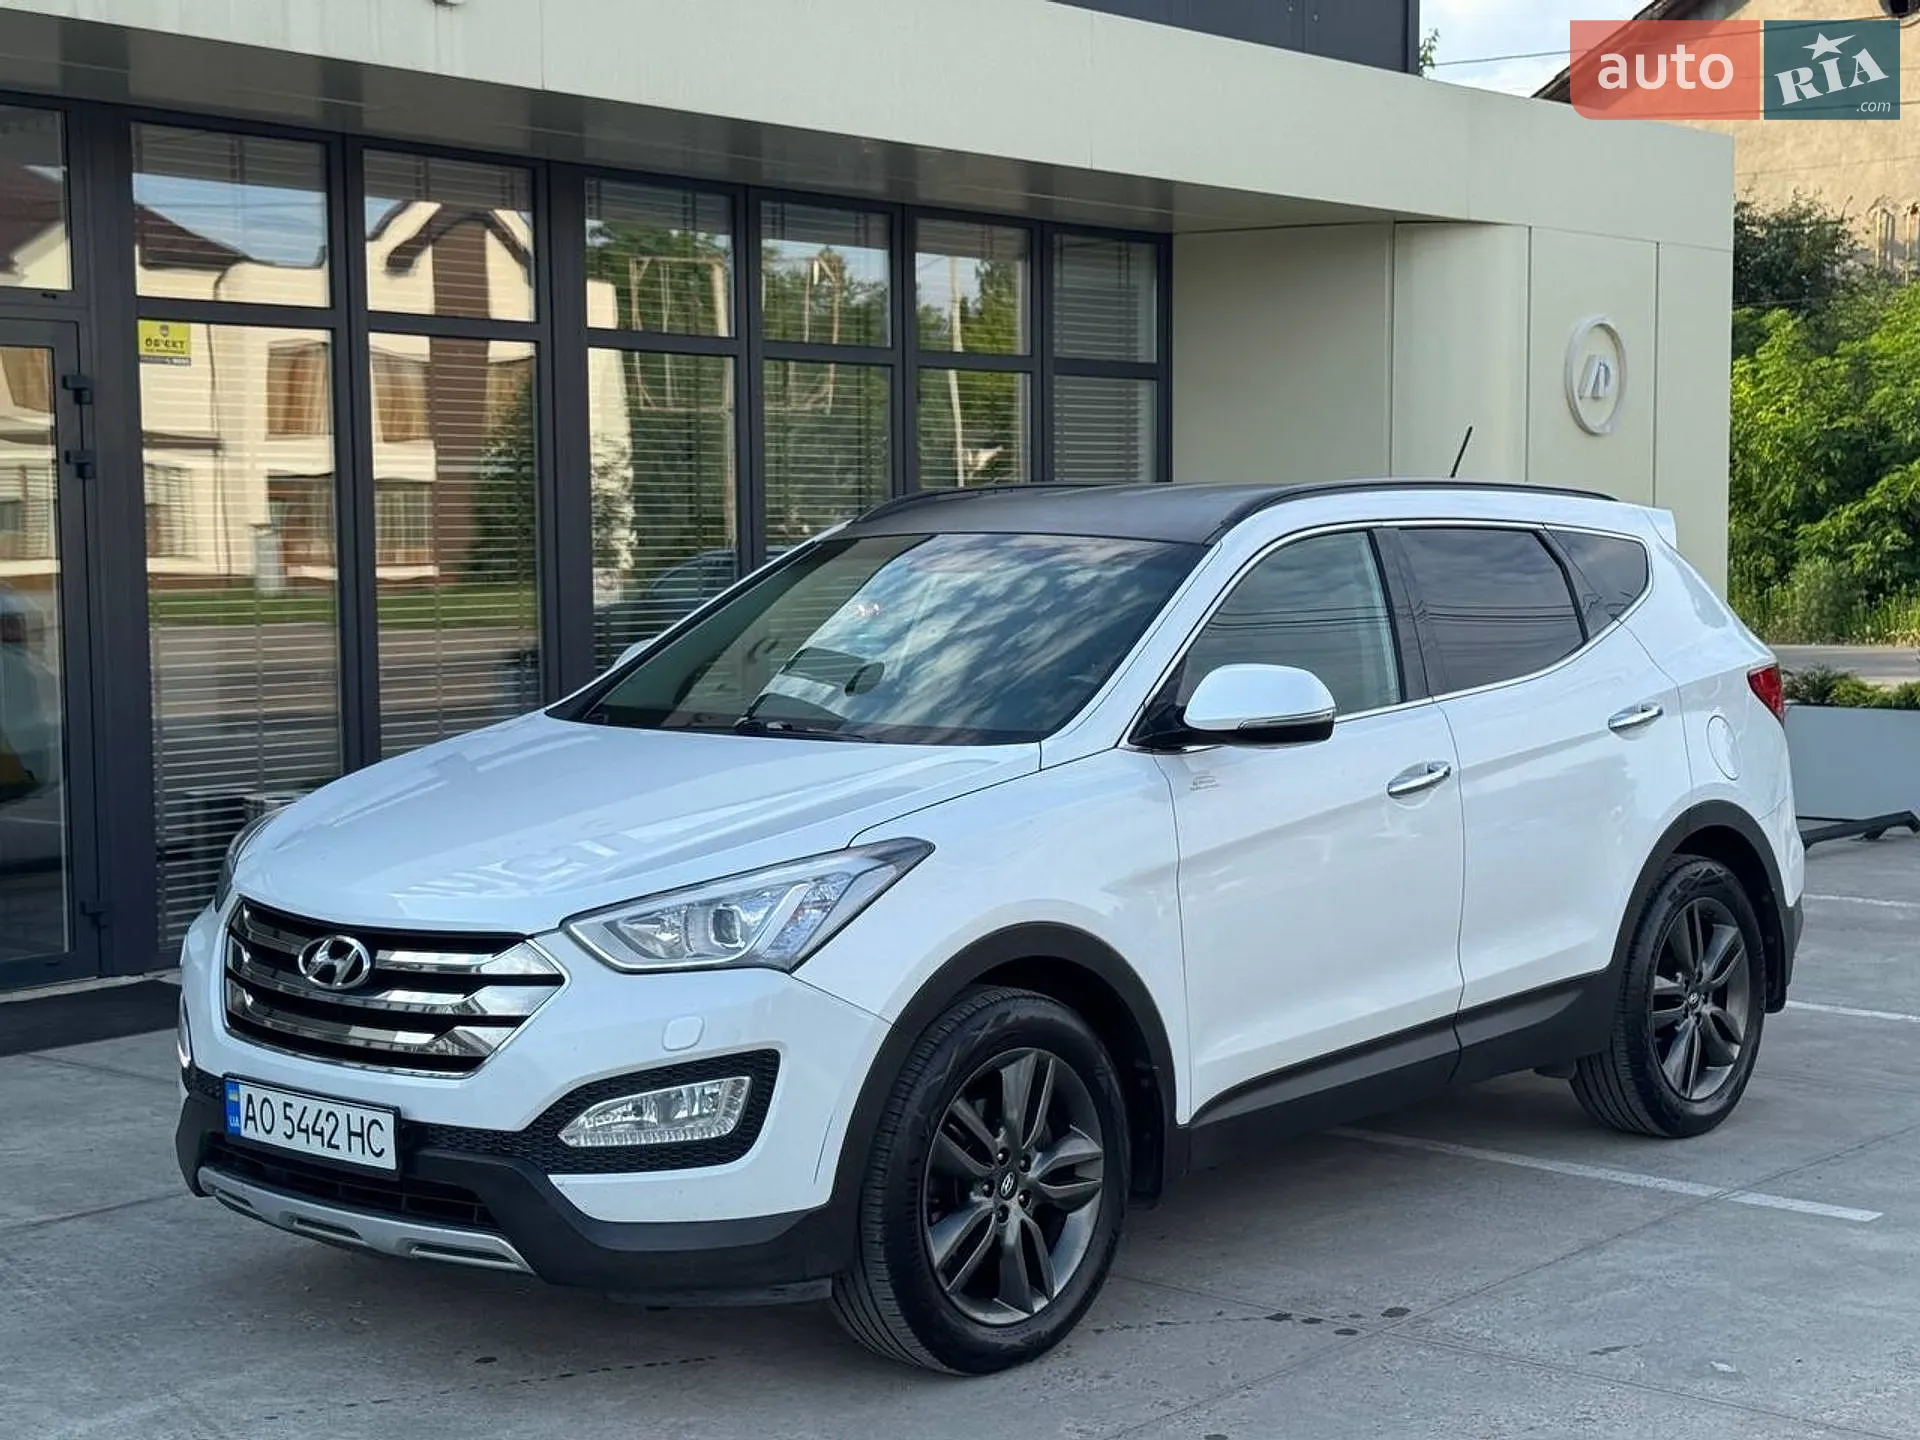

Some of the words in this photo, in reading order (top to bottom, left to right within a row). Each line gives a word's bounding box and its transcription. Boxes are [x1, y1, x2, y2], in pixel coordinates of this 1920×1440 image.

[244, 1093, 275, 1135] AO
[283, 1101, 340, 1150] 5442
[347, 1112, 385, 1158] HC
